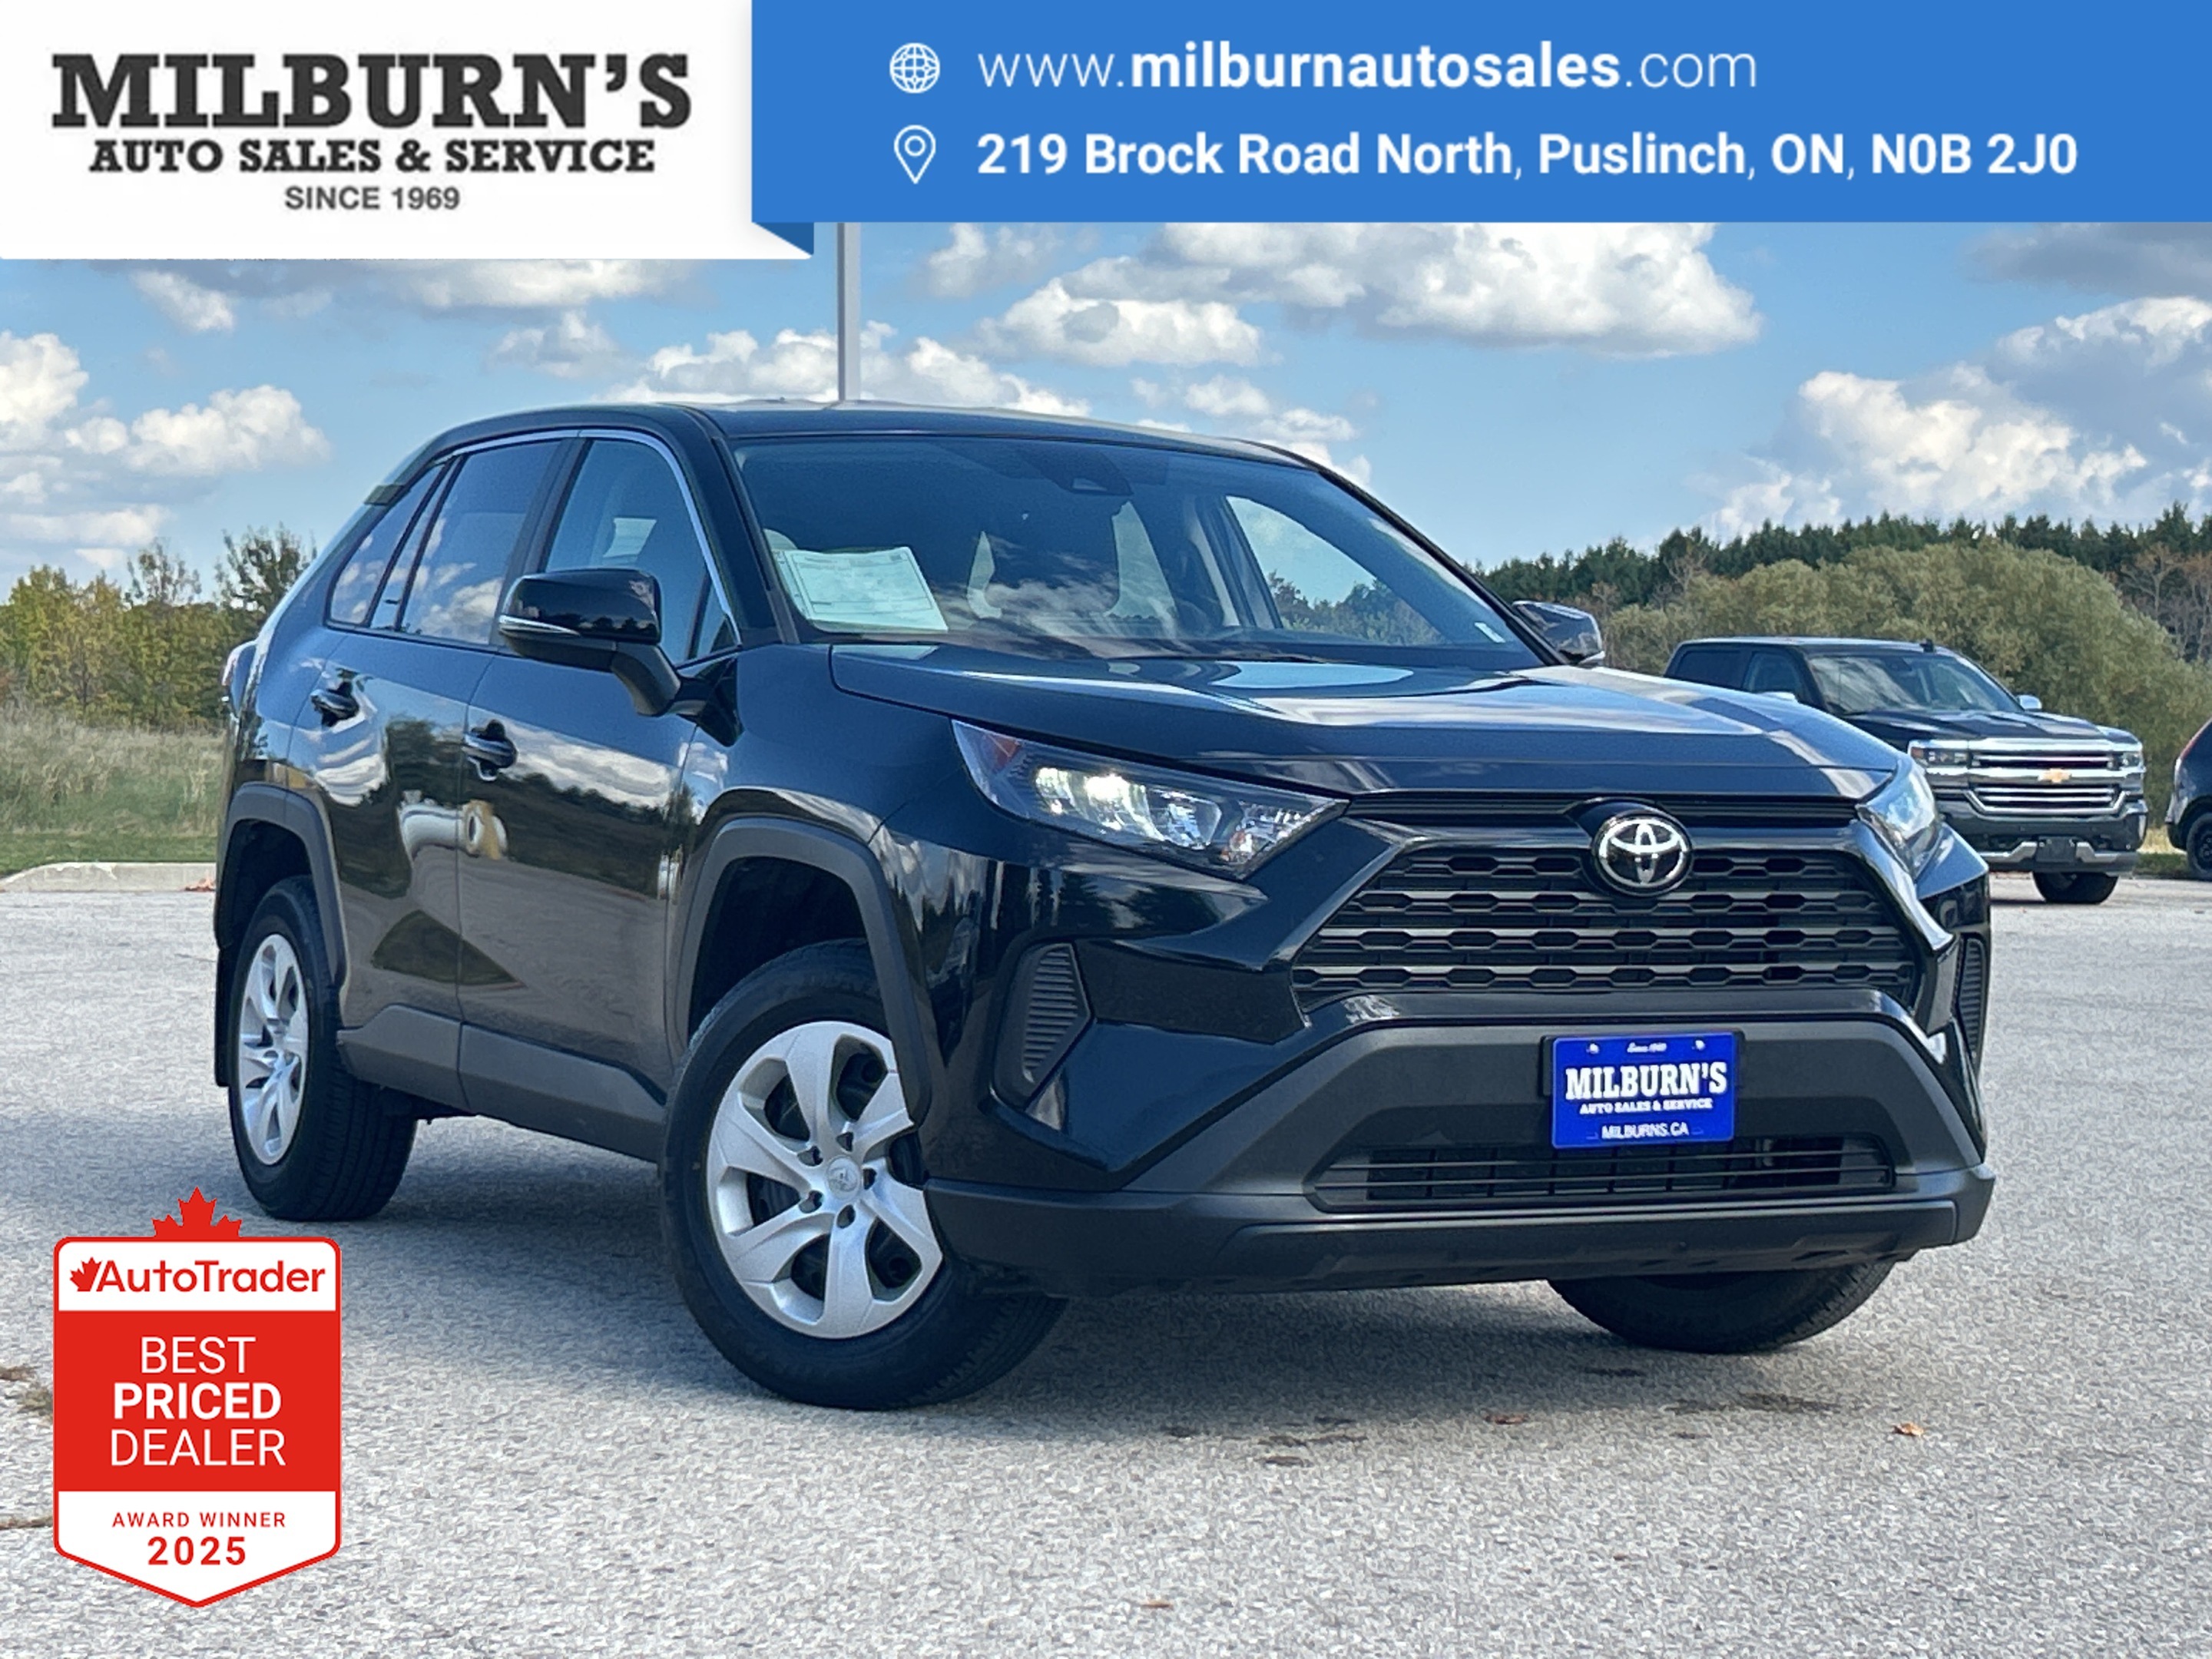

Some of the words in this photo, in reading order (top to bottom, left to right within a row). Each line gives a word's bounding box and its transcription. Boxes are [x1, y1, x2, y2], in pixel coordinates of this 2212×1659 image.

[1565, 1061, 1727, 1100] MILBURN'S
[1579, 1102, 1613, 1114] AUTO
[1614, 1101, 1651, 1113] SALES
[1653, 1101, 1661, 1111] &
[1663, 1098, 1713, 1111] SERVICE
[1601, 1122, 1689, 1139] MILBURNS.CA
